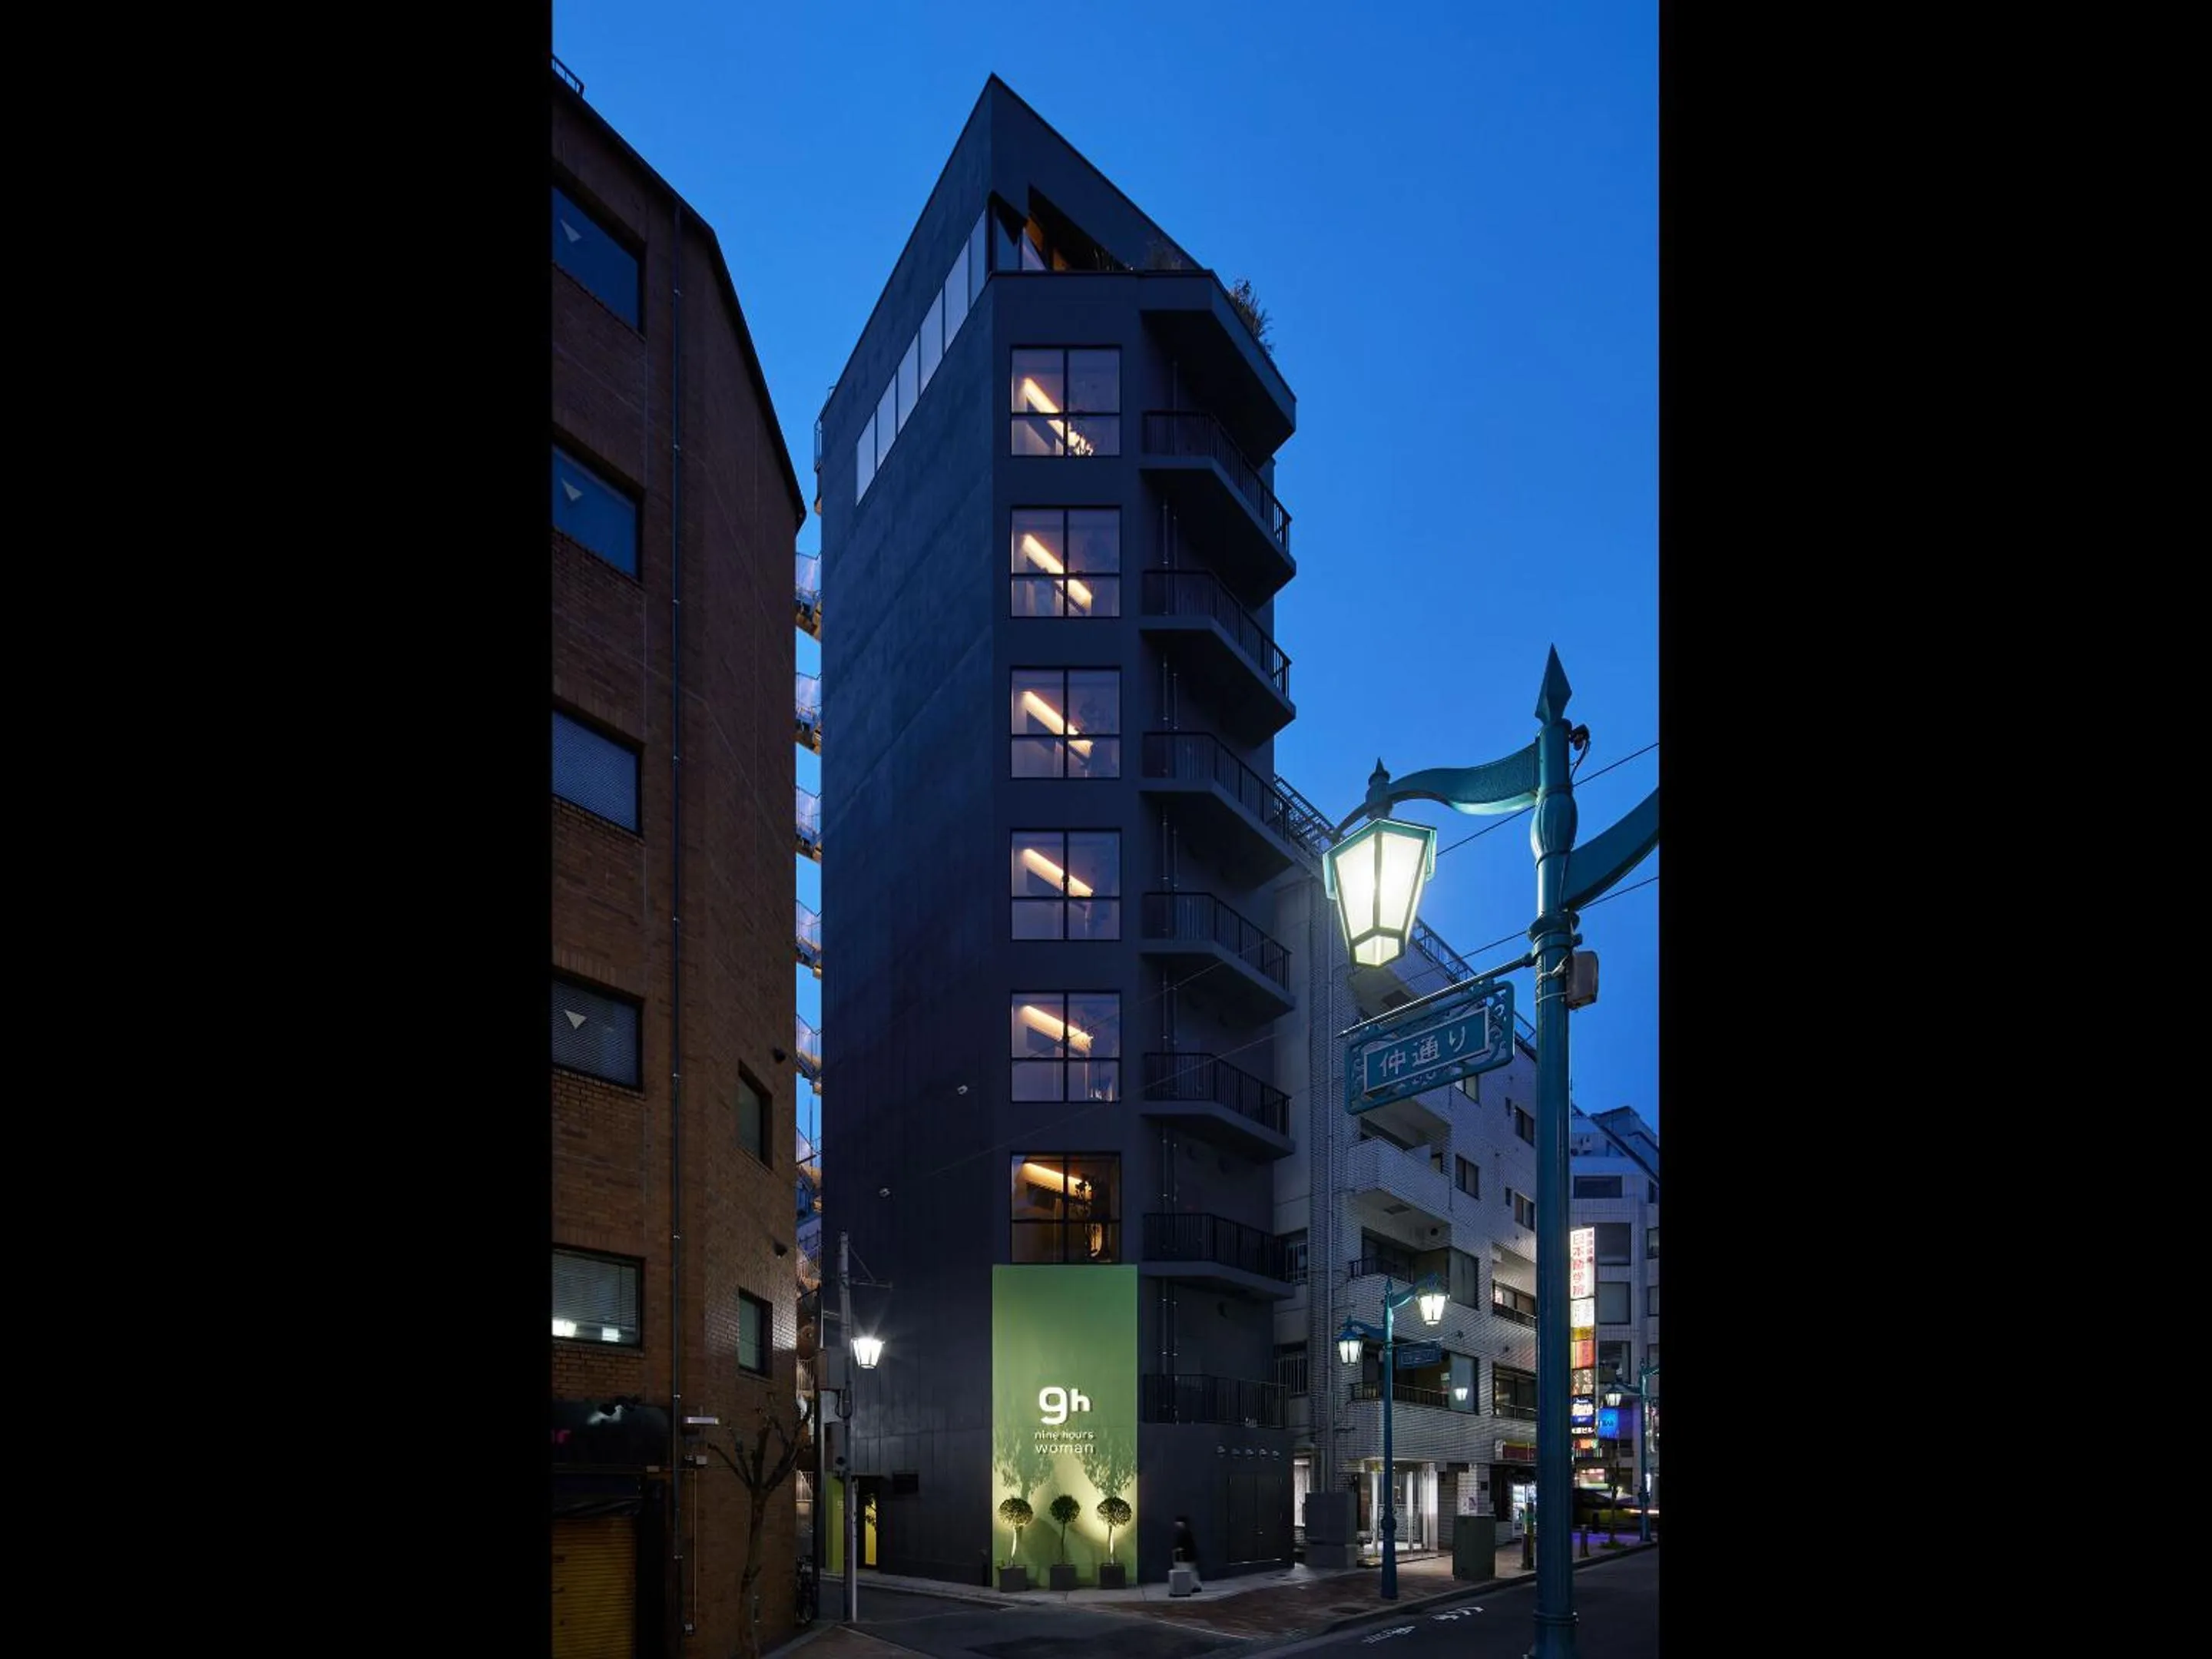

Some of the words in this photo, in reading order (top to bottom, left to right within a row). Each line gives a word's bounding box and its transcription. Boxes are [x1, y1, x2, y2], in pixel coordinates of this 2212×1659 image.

[1379, 1025, 1465, 1077] 仲通り
[1039, 1386, 1091, 1425] 9h
[1035, 1429, 1059, 1440] nine
[1062, 1429, 1094, 1440] hours
[1035, 1443, 1094, 1454] woman
